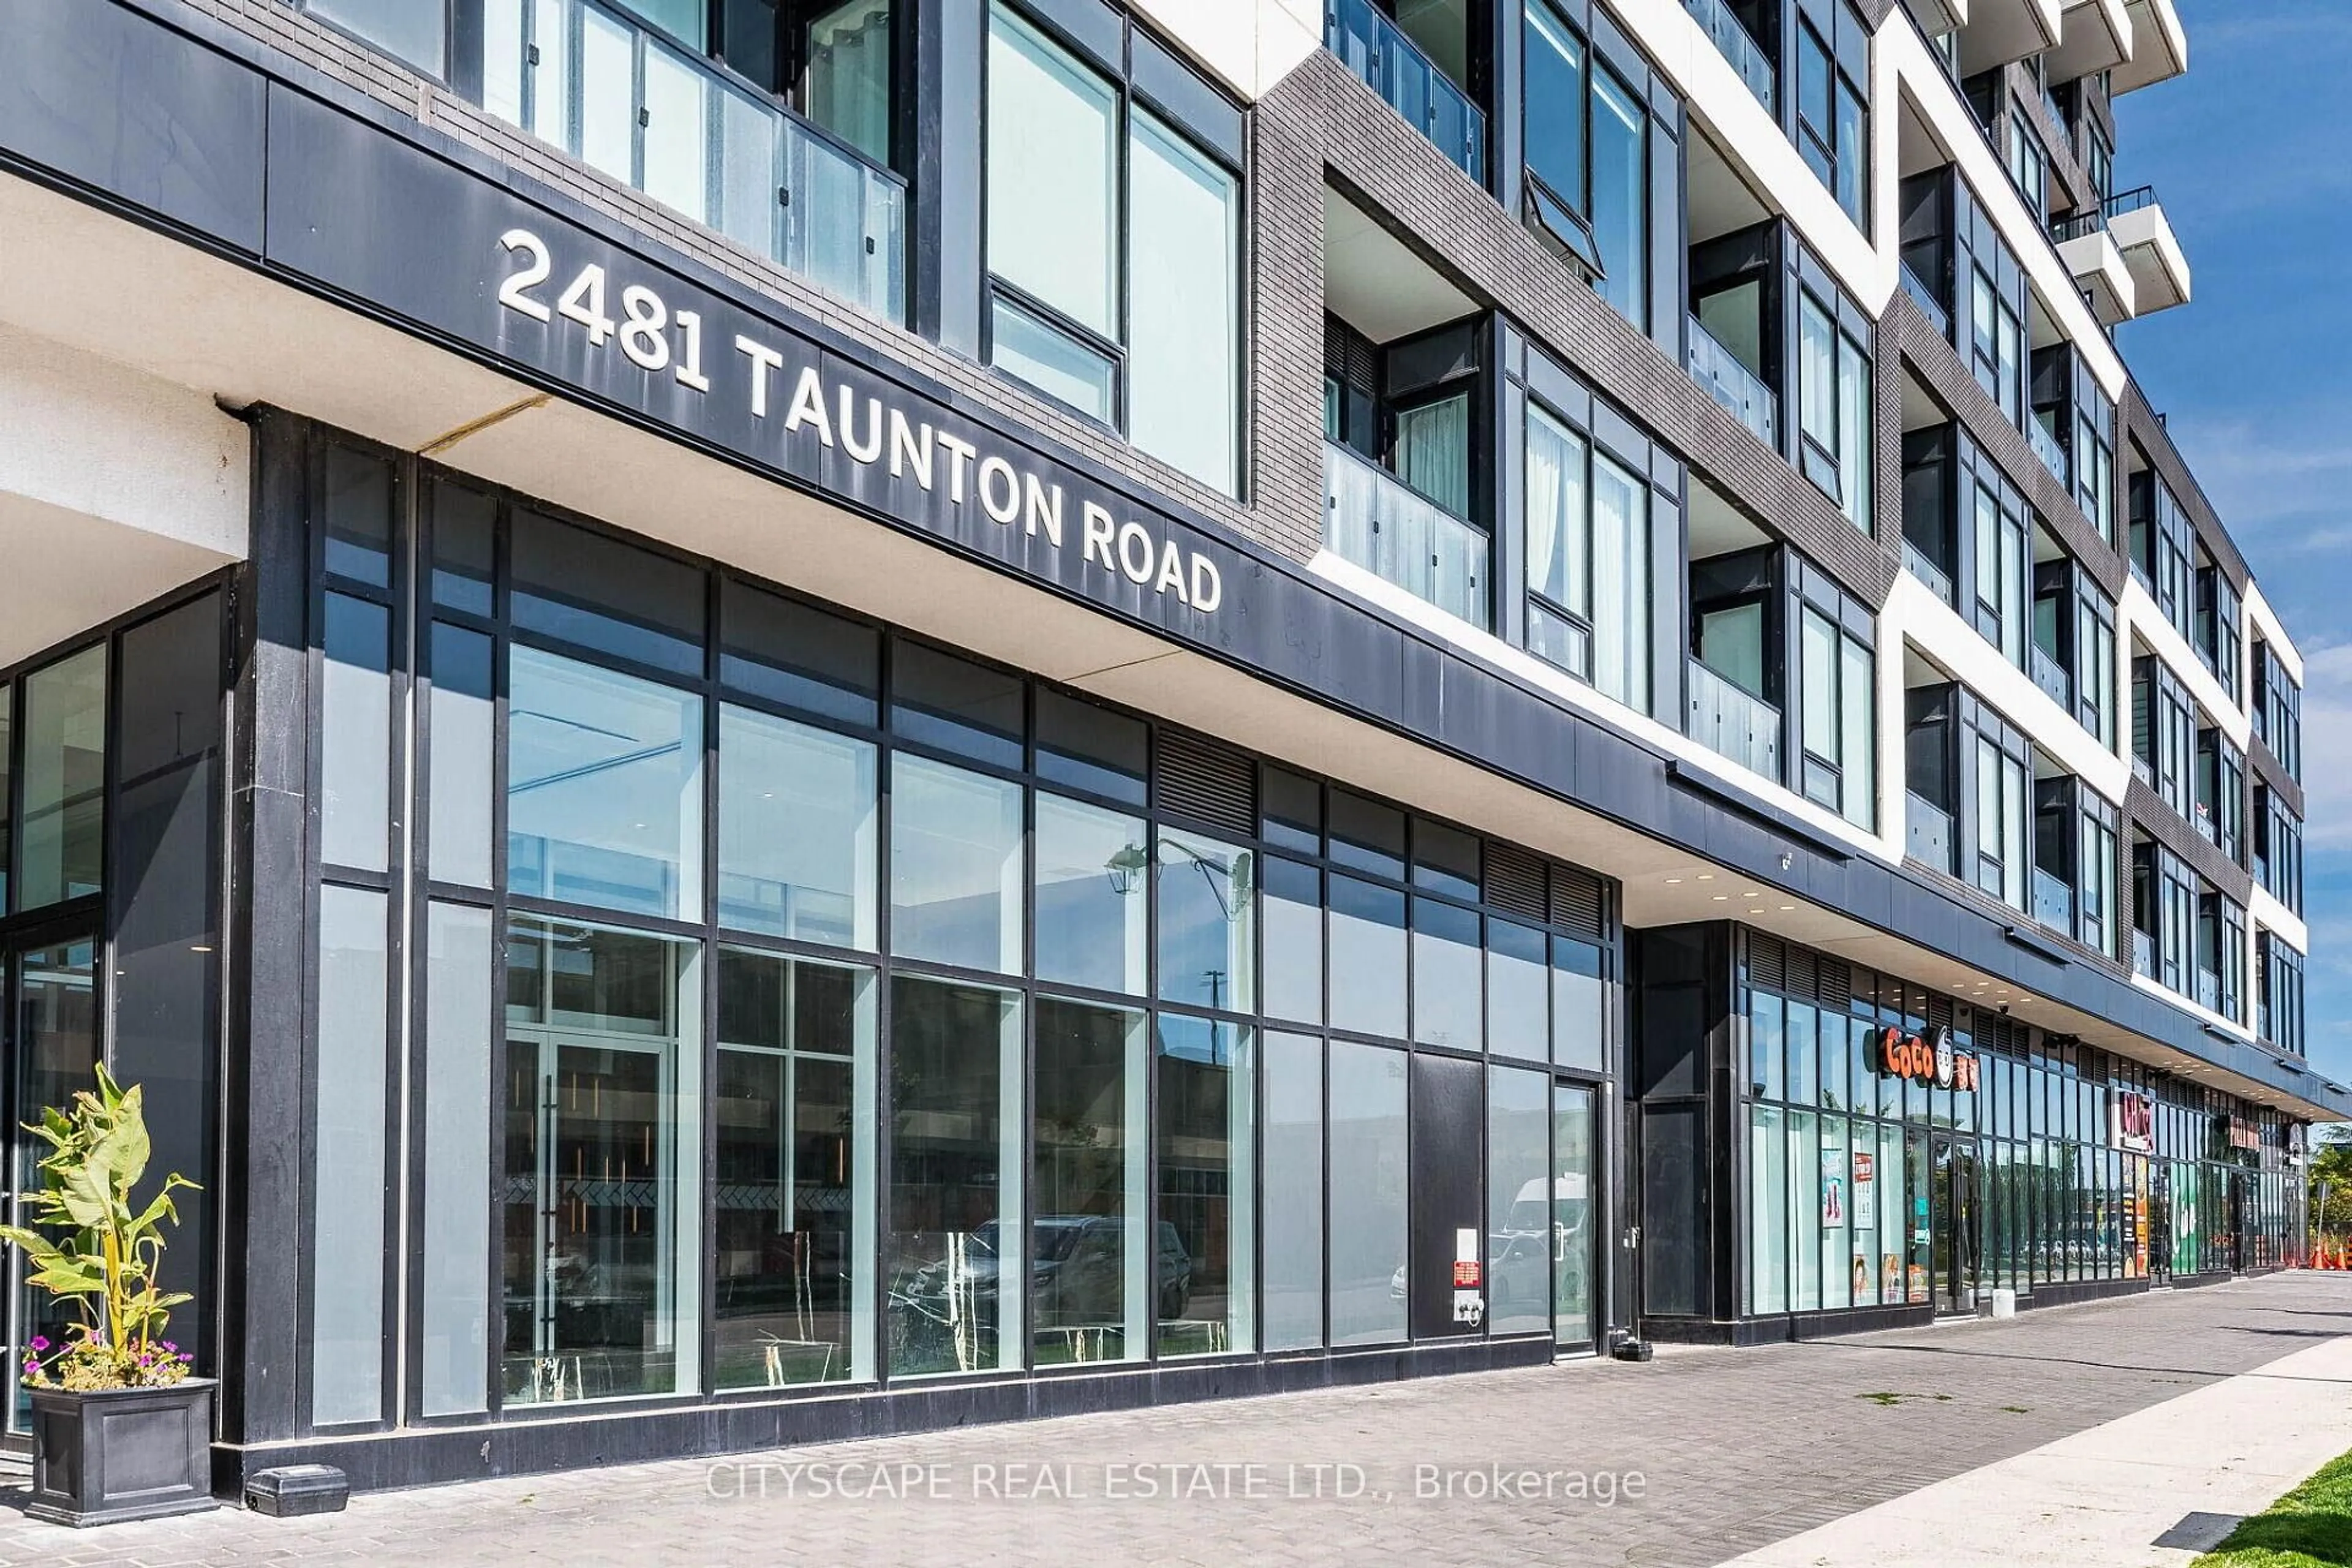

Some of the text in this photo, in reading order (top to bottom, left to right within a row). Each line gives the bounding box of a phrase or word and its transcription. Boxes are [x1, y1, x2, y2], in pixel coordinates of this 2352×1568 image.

[497, 228, 1222, 613] 2481 TAUNTON ROAD
